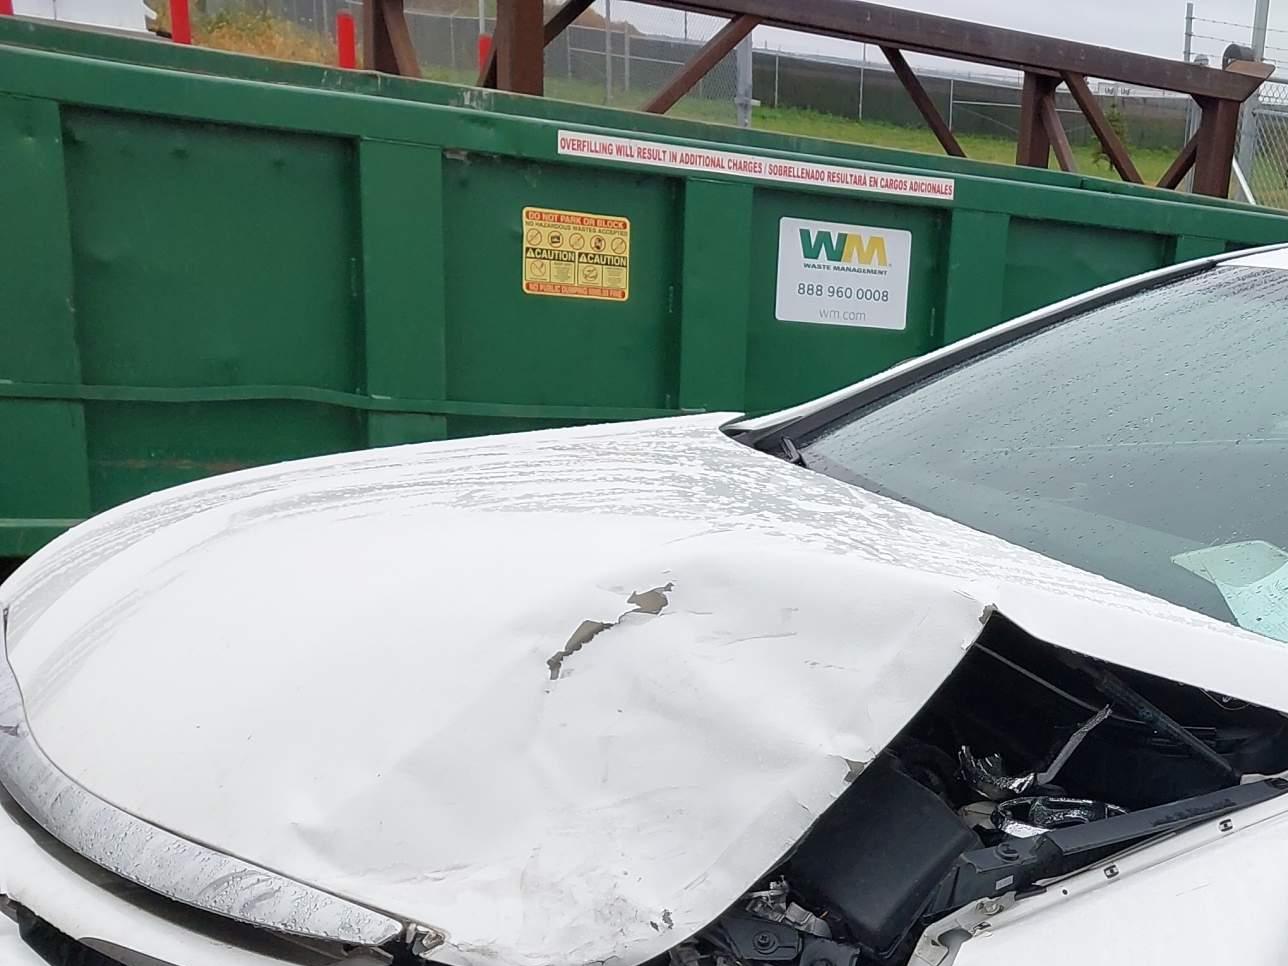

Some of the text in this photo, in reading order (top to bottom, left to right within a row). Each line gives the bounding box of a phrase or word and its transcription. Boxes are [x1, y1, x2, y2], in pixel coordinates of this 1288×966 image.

[560, 137, 613, 155] OVERFILLING
[616, 144, 634, 158] WILL
[637, 147, 667, 161] RESULT
[669, 152, 677, 163] IN
[680, 154, 725, 169] ADDITIONAL
[728, 158, 762, 174] CHARGES
[768, 163, 825, 181] SOBRELLENADO
[869, 176, 878, 188] EN
[880, 178, 908, 191] CARGOS
[909, 182, 953, 196] ADICIONALES
[528, 211, 540, 220] DO
[543, 212, 558, 222] NOT
[560, 214, 582, 224] PARK
[597, 218, 625, 229] BLOCK
[534, 248, 575, 261] CAUTION
[799, 228, 888, 267] WM
[586, 253, 627, 266] CAUTION
[803, 262, 888, 275] WASTE MANAGEMENT
[797, 283, 889, 302] 888 960 0008
[819, 308, 866, 321] wm.com
